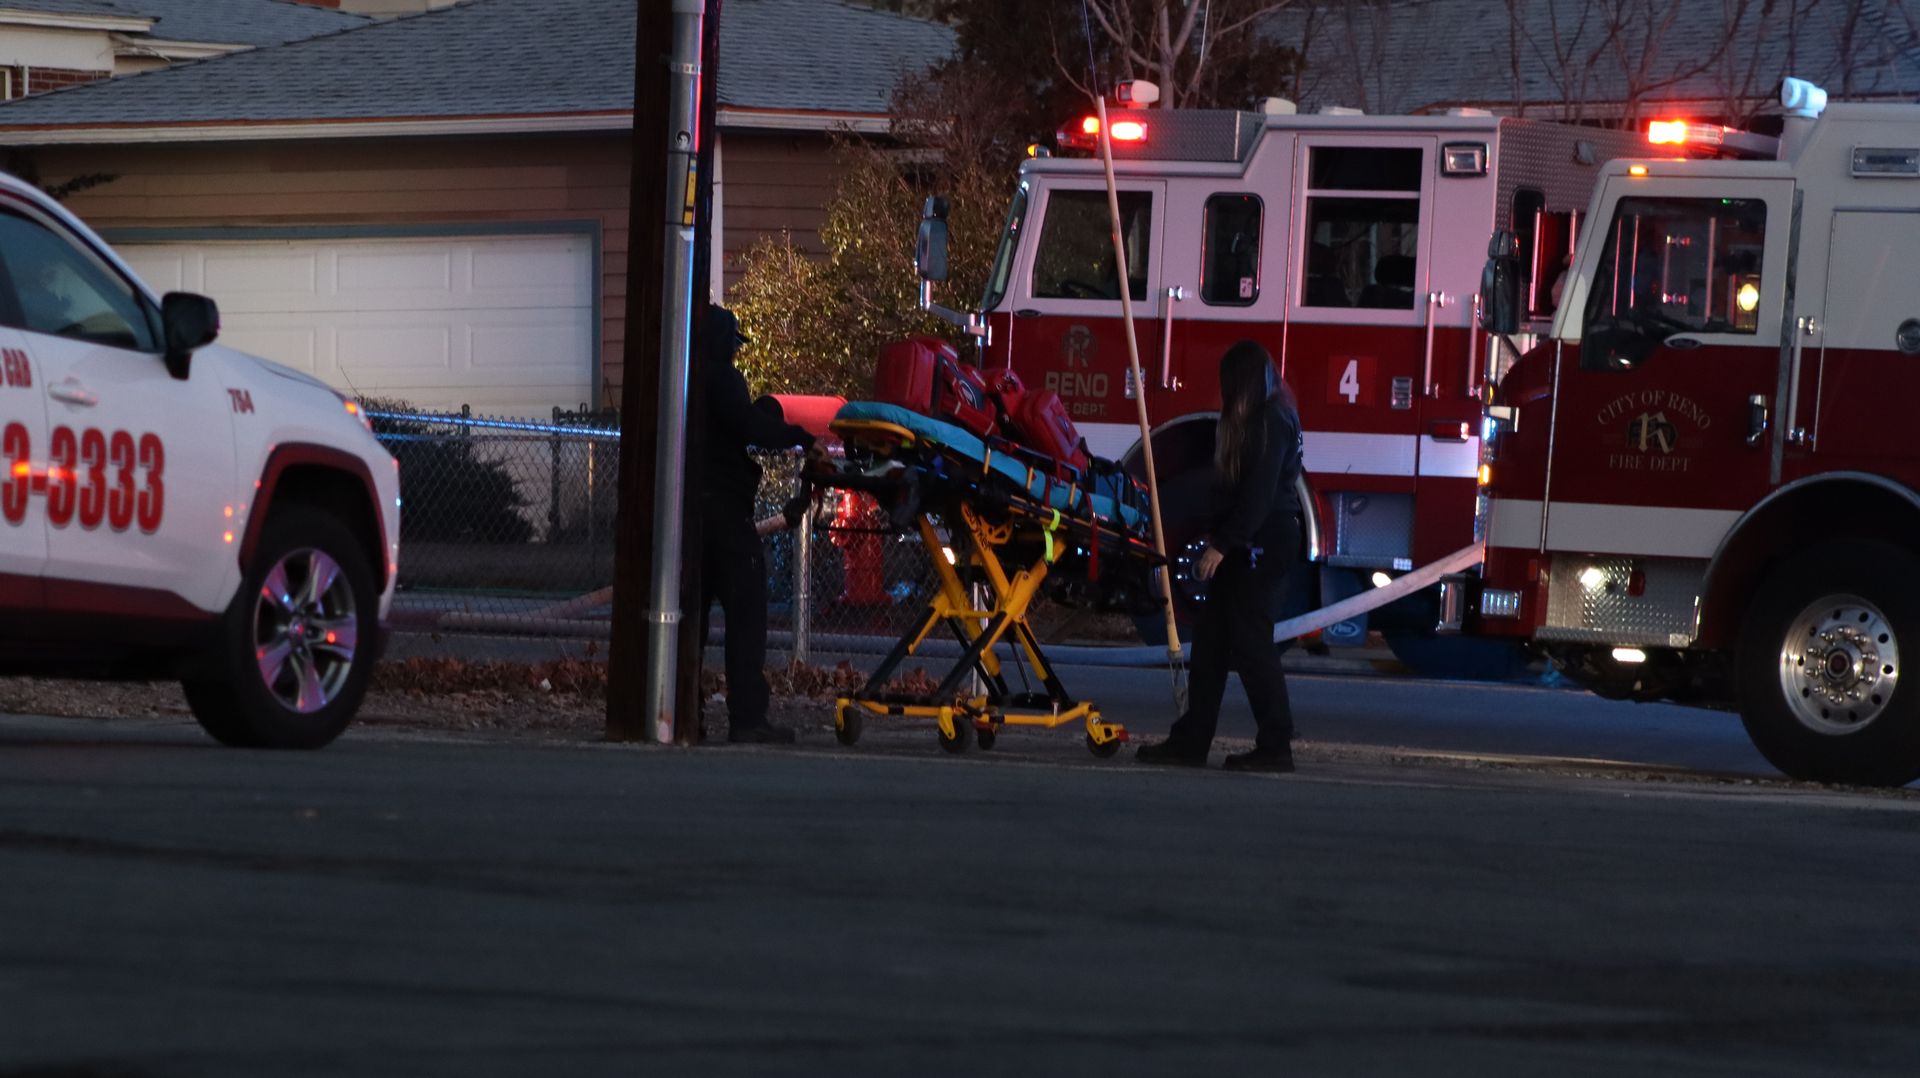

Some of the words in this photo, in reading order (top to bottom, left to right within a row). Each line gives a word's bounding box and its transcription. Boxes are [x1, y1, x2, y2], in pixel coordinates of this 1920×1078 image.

[2, 347, 32, 388] CAB
[1045, 370, 1109, 398] RENO
[1338, 359, 1360, 404] 4
[1597, 391, 1635, 425] CITY
[1640, 389, 1665, 406] OF
[1667, 391, 1711, 430] RENO
[1, 421, 165, 535] 3-3333
[1608, 453, 1645, 470] FIRE
[1649, 454, 1691, 472] DEPT
